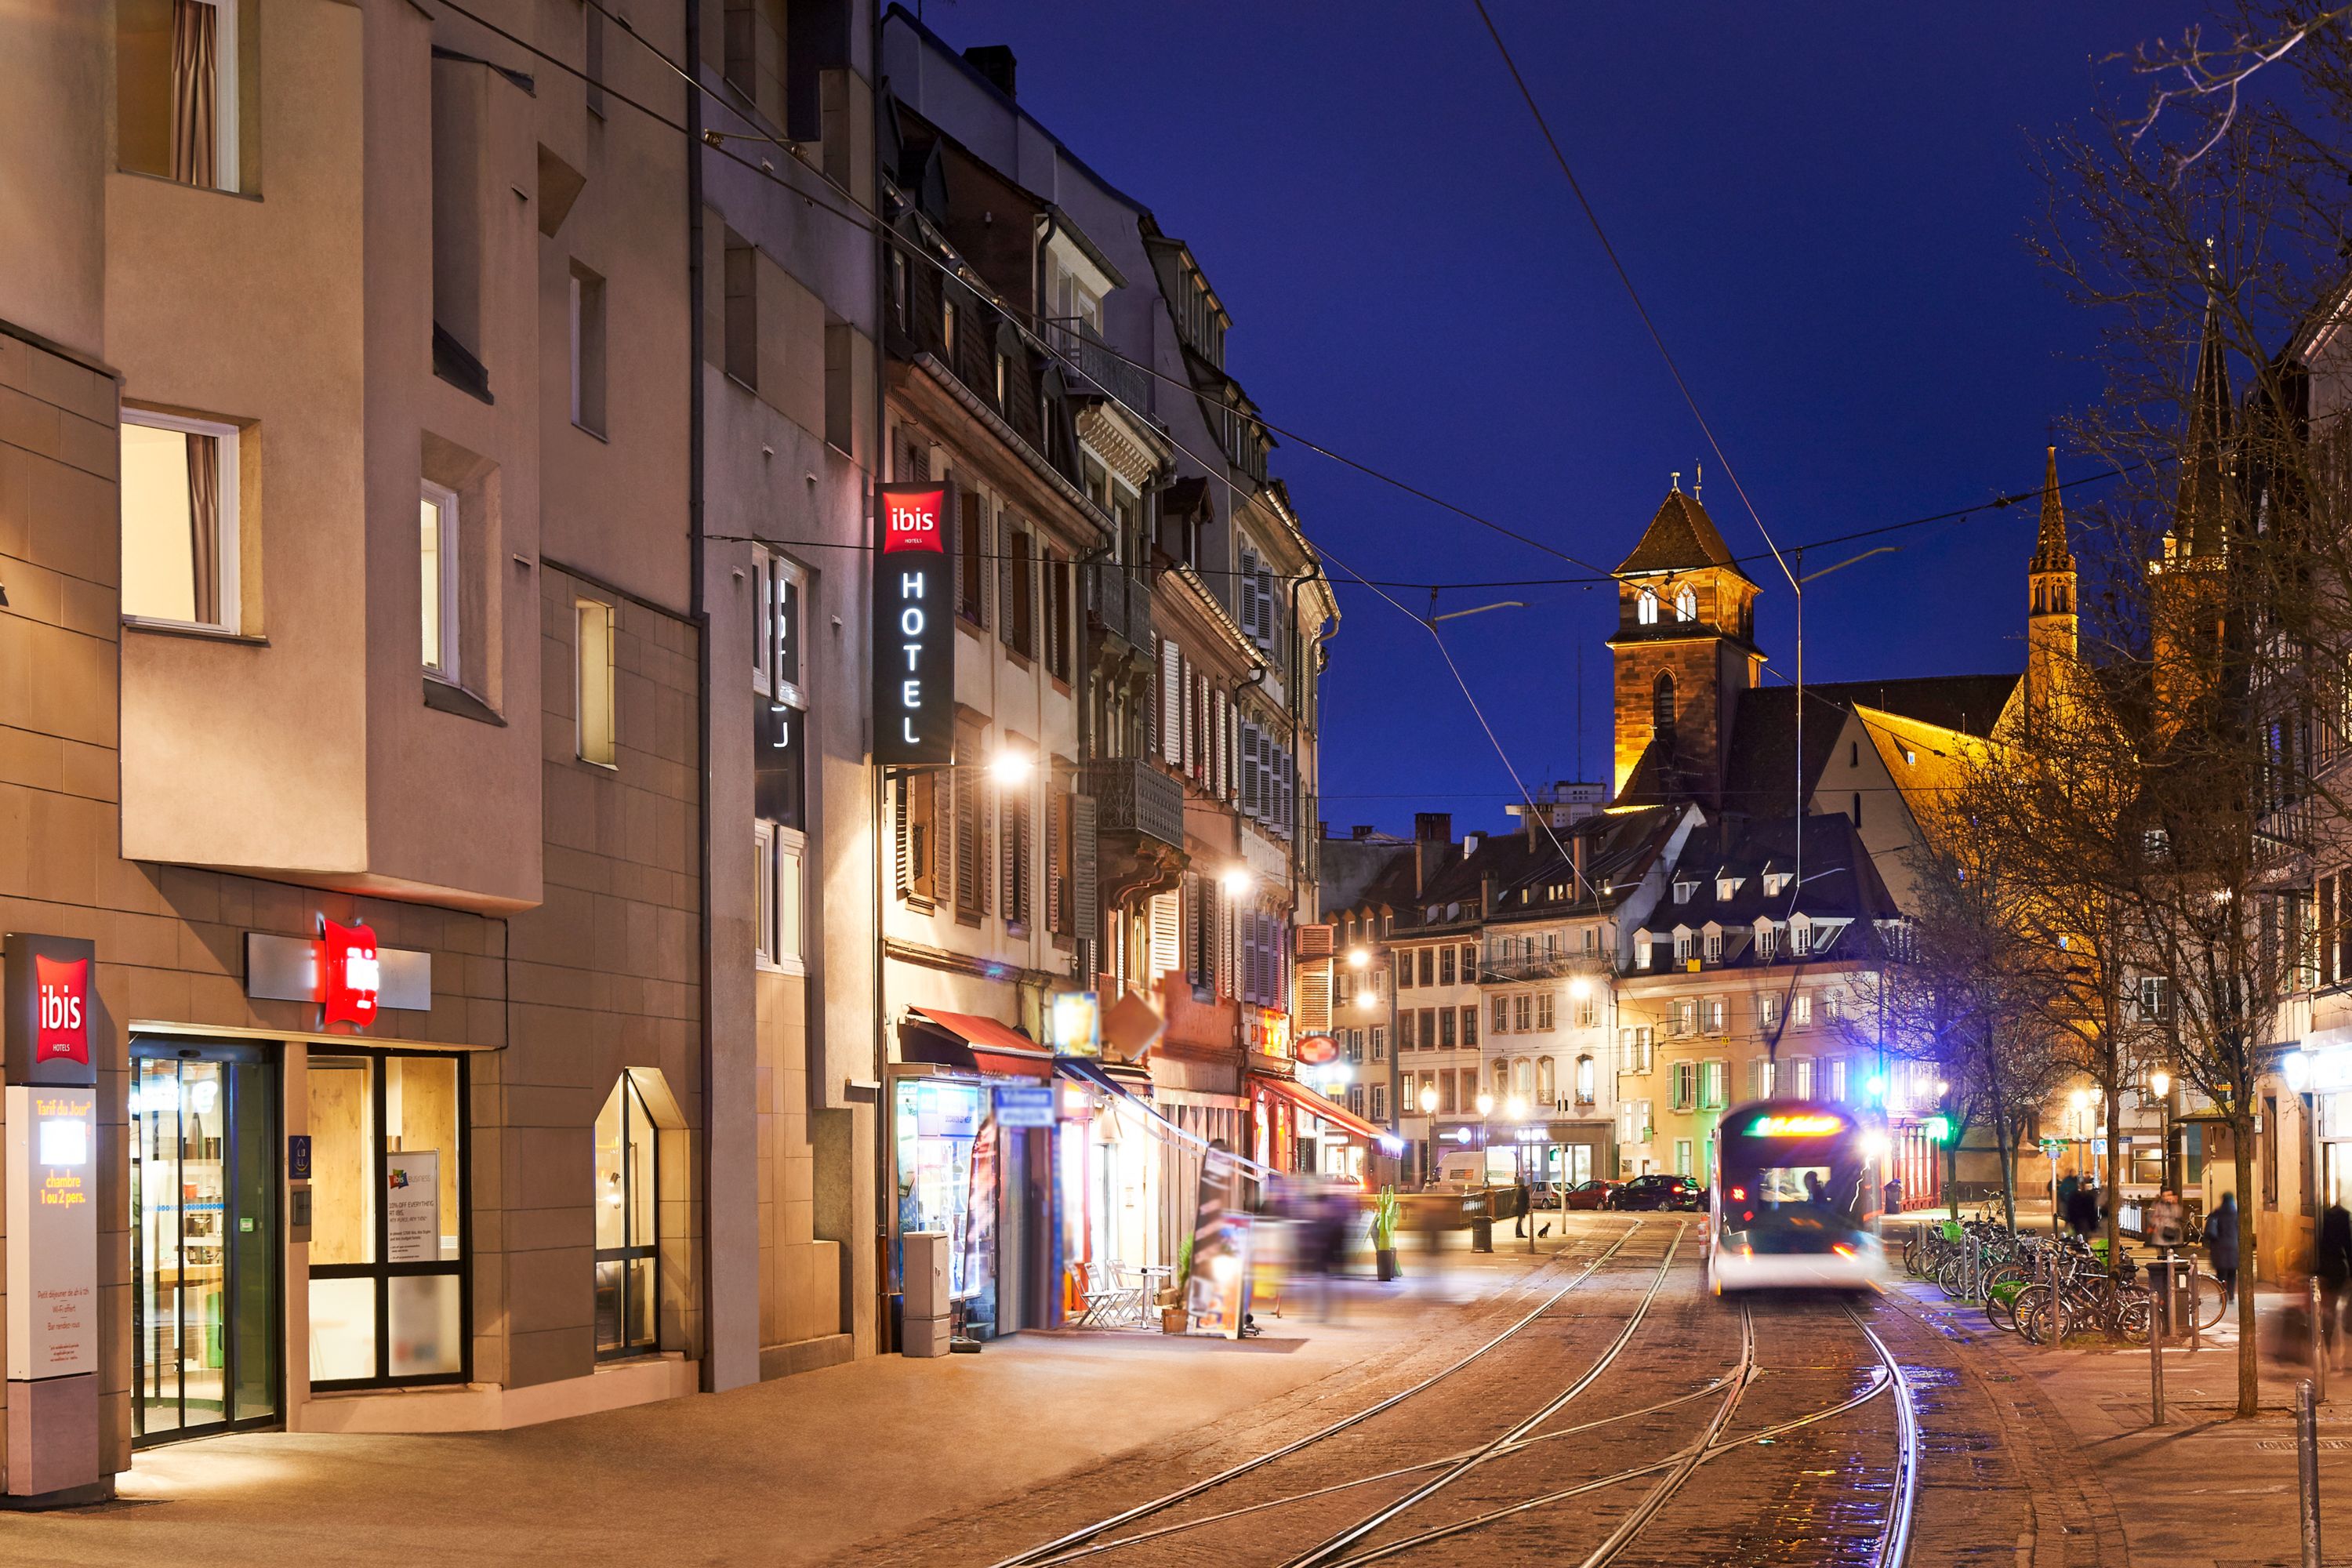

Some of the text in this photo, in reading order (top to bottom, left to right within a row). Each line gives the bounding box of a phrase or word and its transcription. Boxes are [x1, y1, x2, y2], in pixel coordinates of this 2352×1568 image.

[892, 507, 934, 531] ibis
[902, 572, 924, 743] HOTEL
[42, 985, 82, 1029] ibis
[36, 1099, 56, 1116] Tarif
[57, 1100, 68, 1116] du
[45, 1168, 81, 1189] chambre
[40, 1189, 86, 1208] 1 ou 2 pers.
